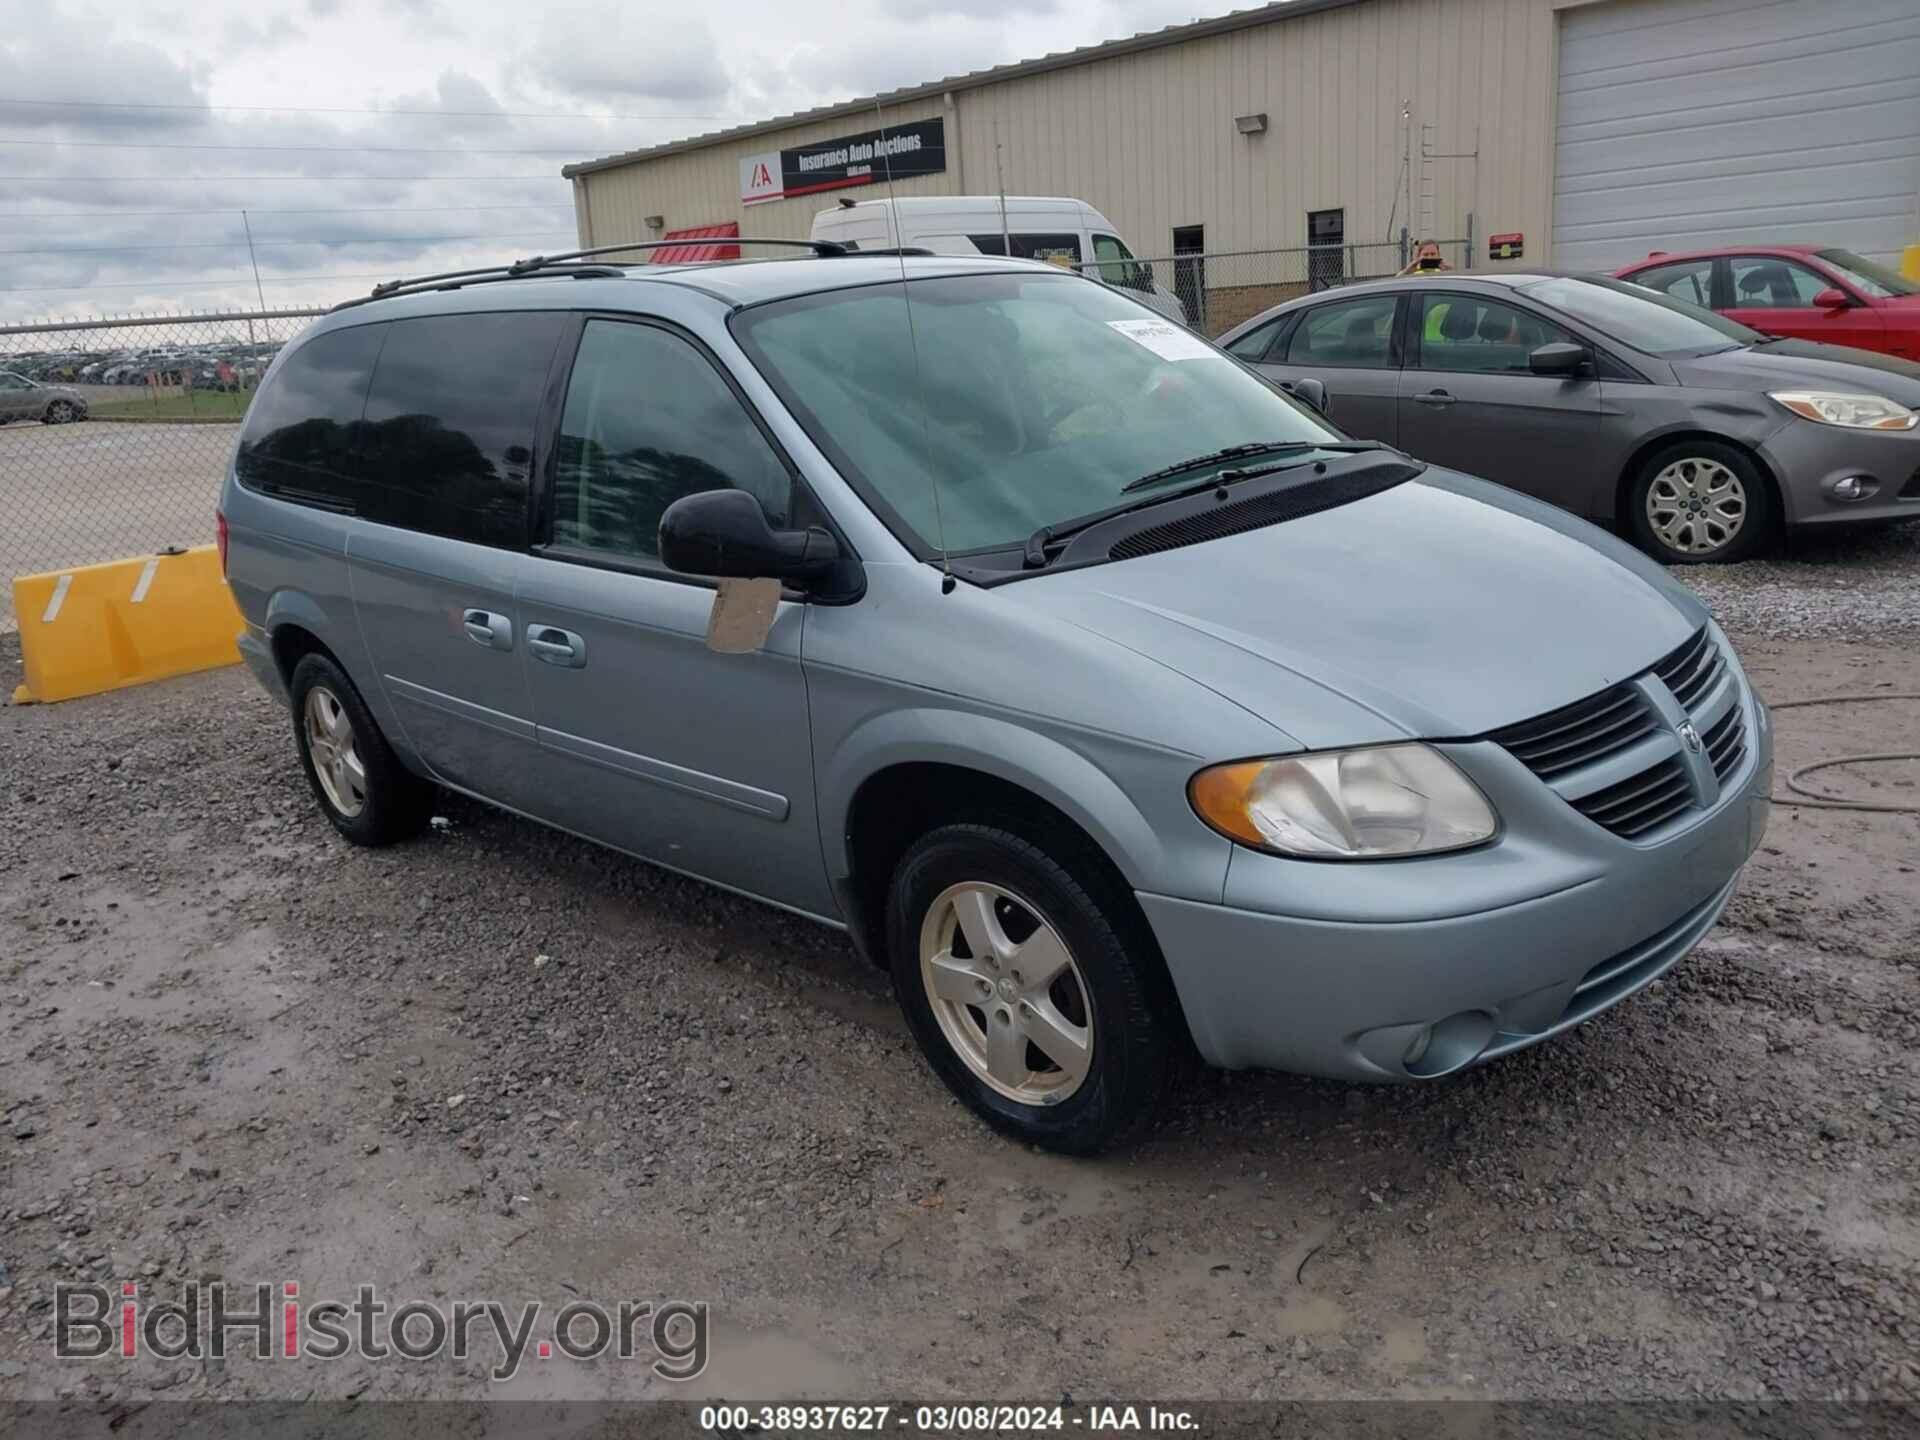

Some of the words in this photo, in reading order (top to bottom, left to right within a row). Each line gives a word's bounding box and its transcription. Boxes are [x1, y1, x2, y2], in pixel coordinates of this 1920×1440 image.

[799, 148, 849, 172] Insurance
[849, 143, 873, 162] Auto
[874, 133, 921, 156] Auctions
